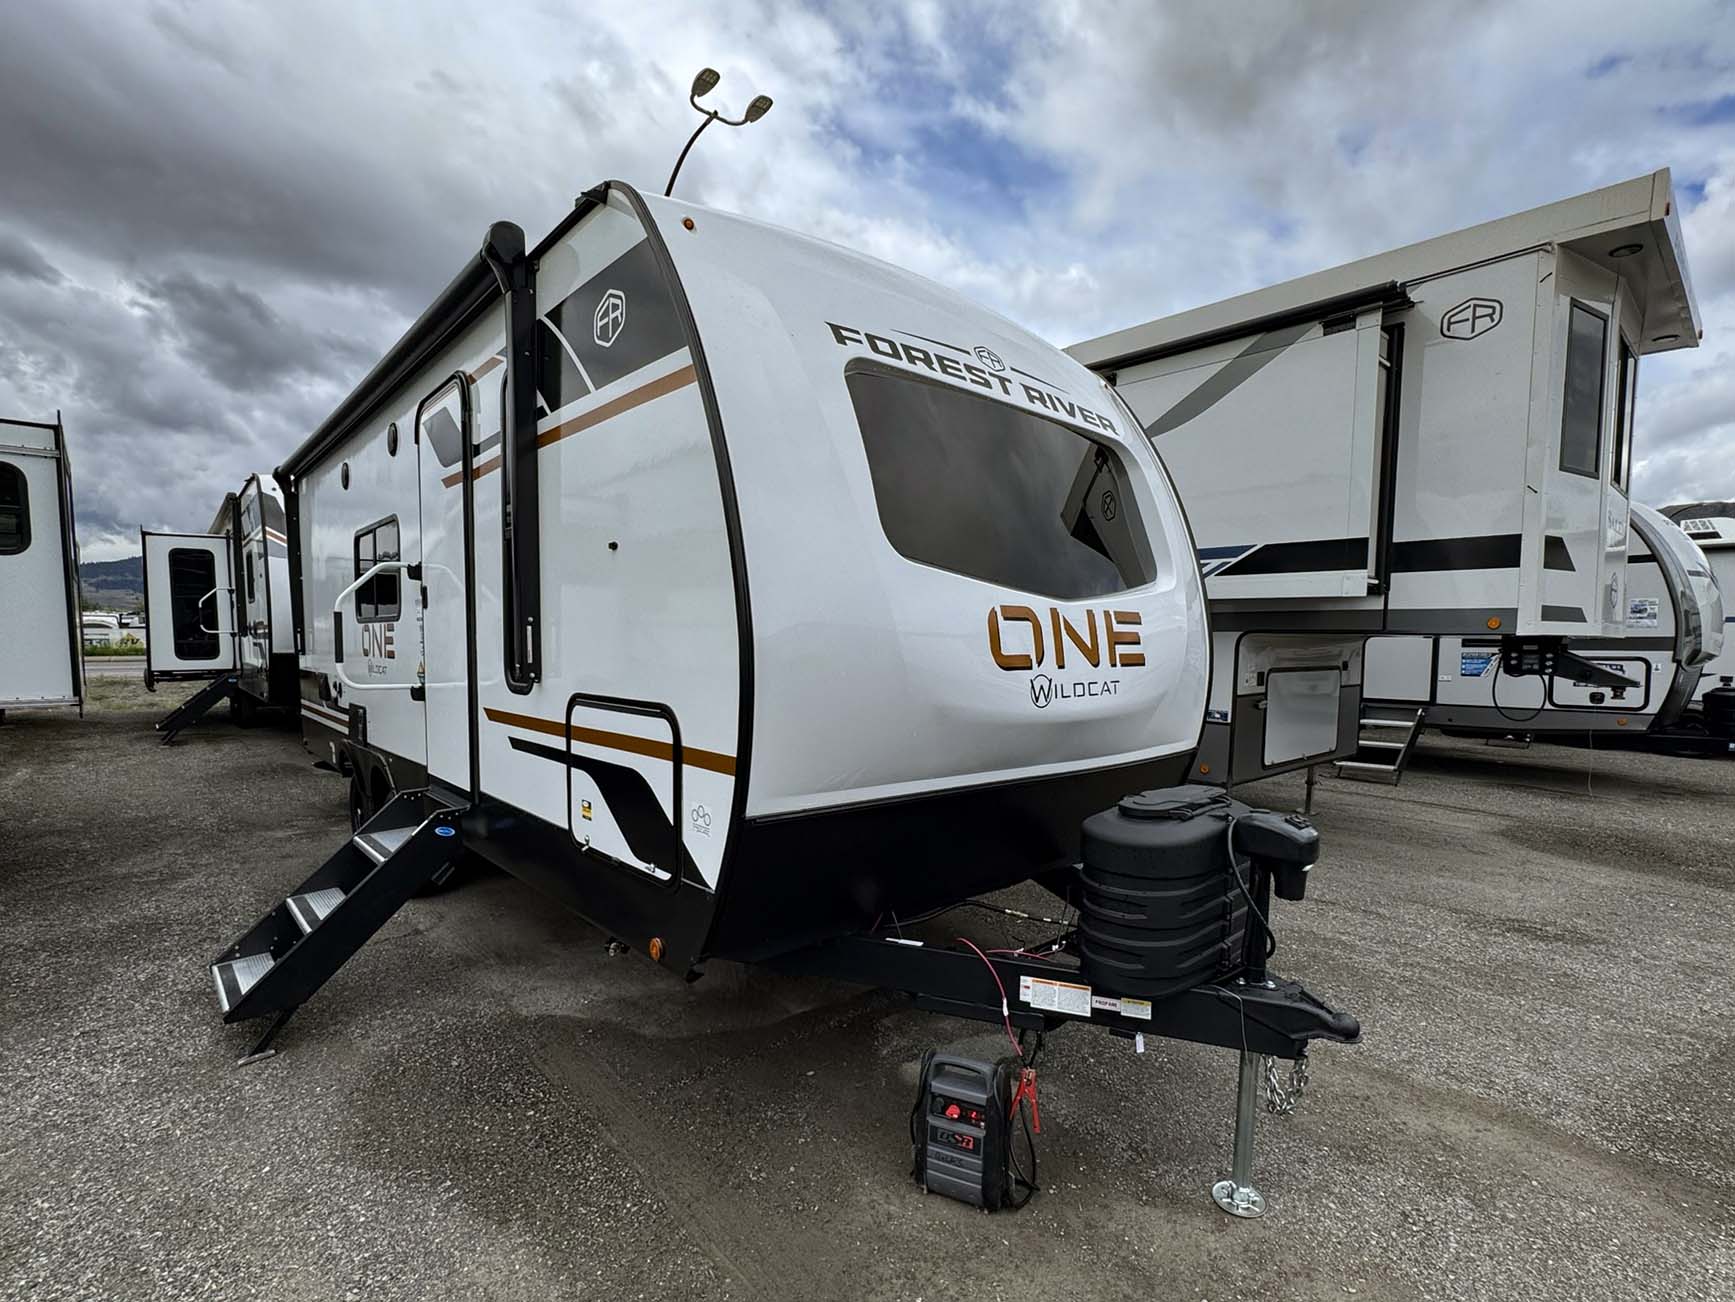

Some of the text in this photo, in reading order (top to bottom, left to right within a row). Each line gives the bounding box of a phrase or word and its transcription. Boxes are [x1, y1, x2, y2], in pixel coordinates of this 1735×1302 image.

[824, 321, 1120, 437] FOREST RIVER
[362, 623, 395, 659] ONE
[987, 604, 1146, 672] ONE
